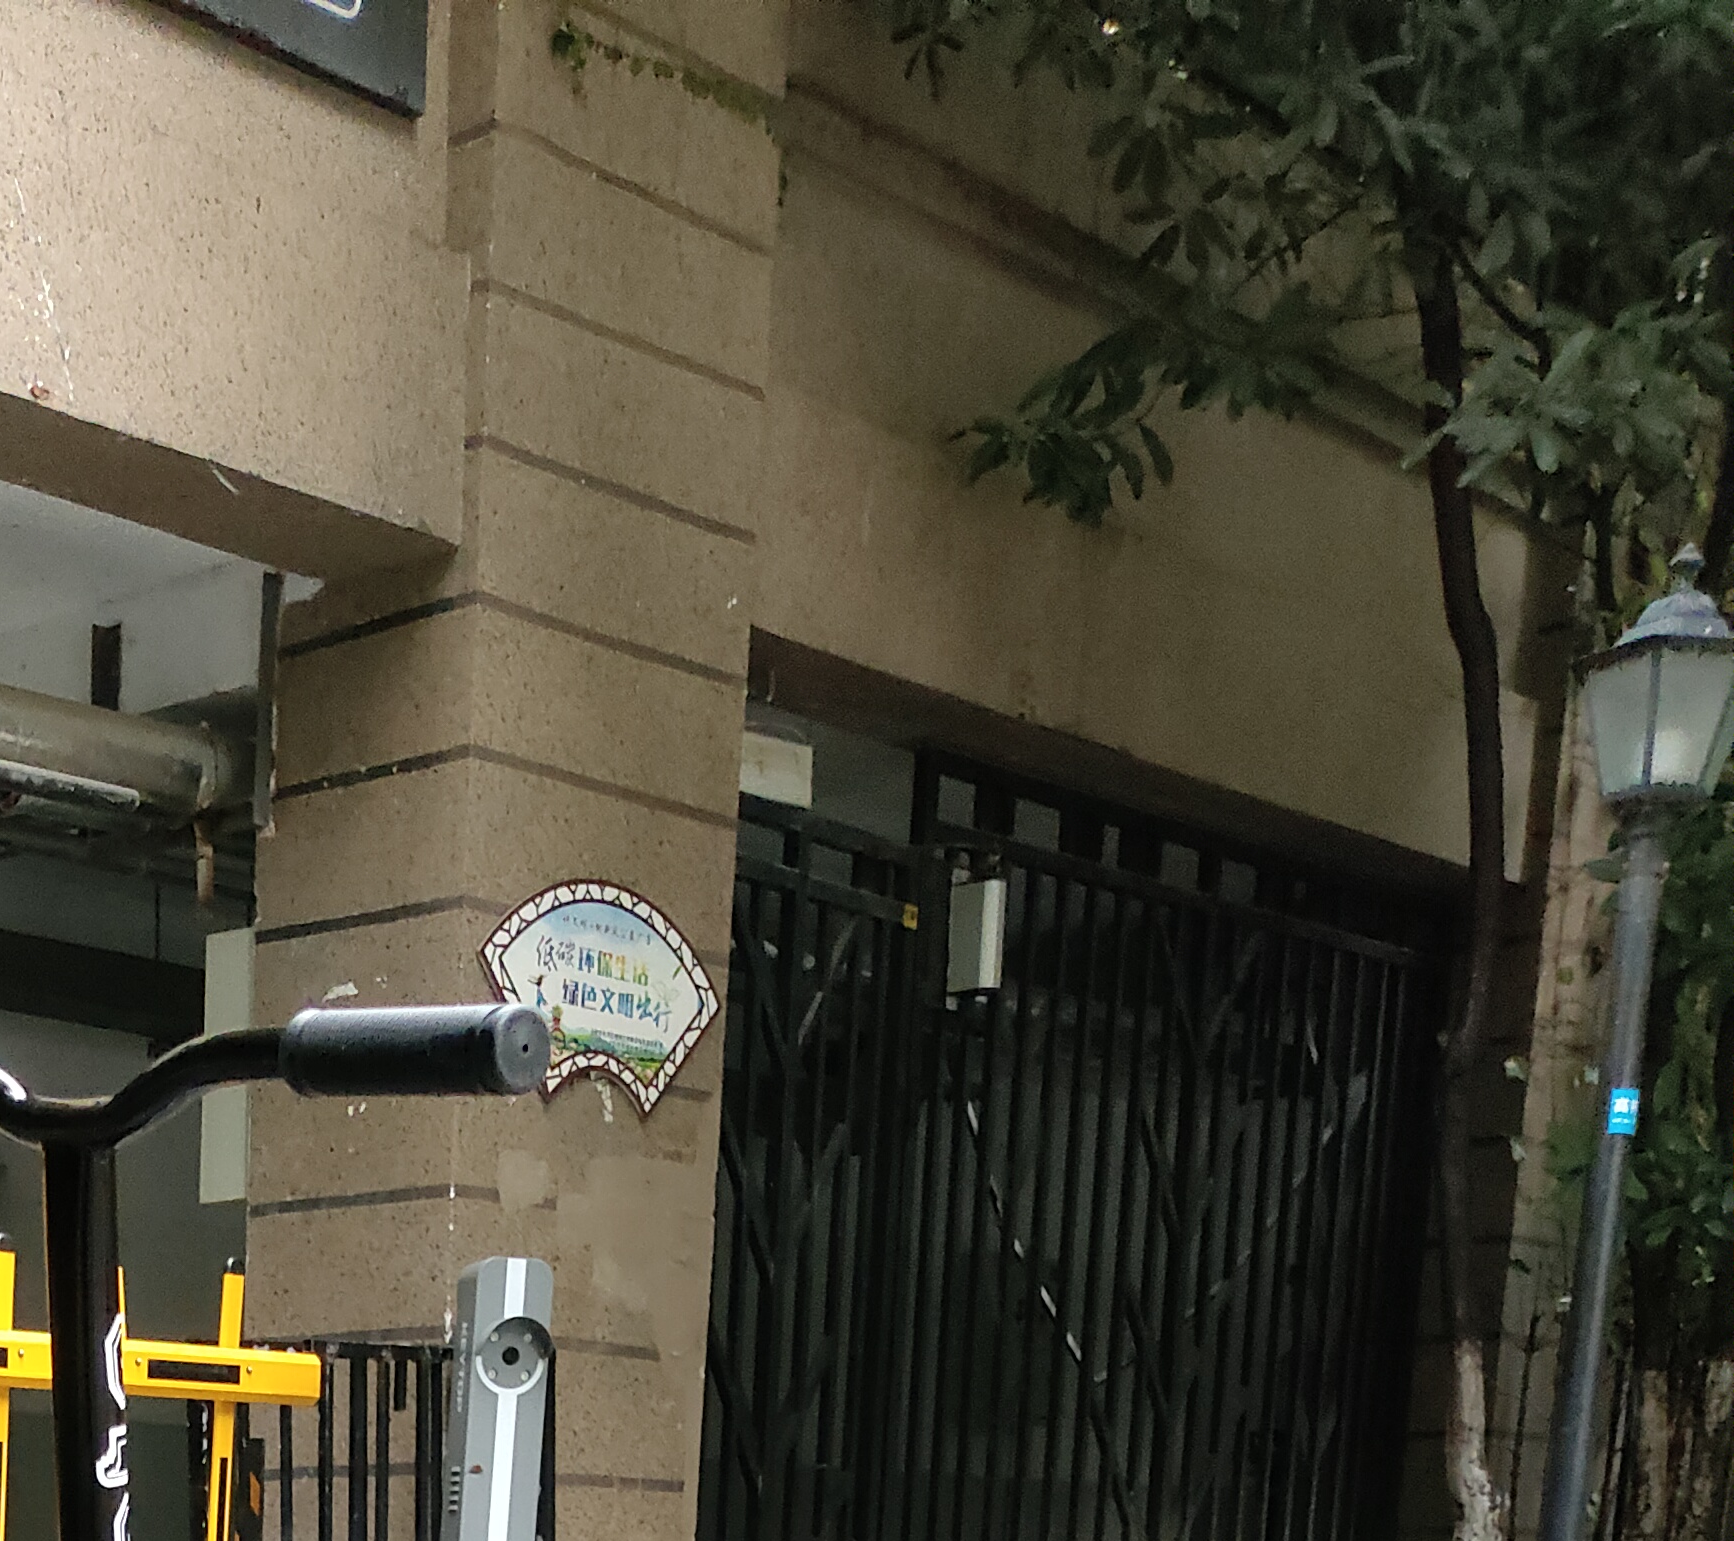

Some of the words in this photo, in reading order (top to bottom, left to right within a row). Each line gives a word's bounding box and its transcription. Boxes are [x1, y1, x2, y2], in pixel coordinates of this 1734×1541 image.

[536, 935, 649, 987] 低碳环保生活
[562, 978, 673, 1034] 绿色文明出行
